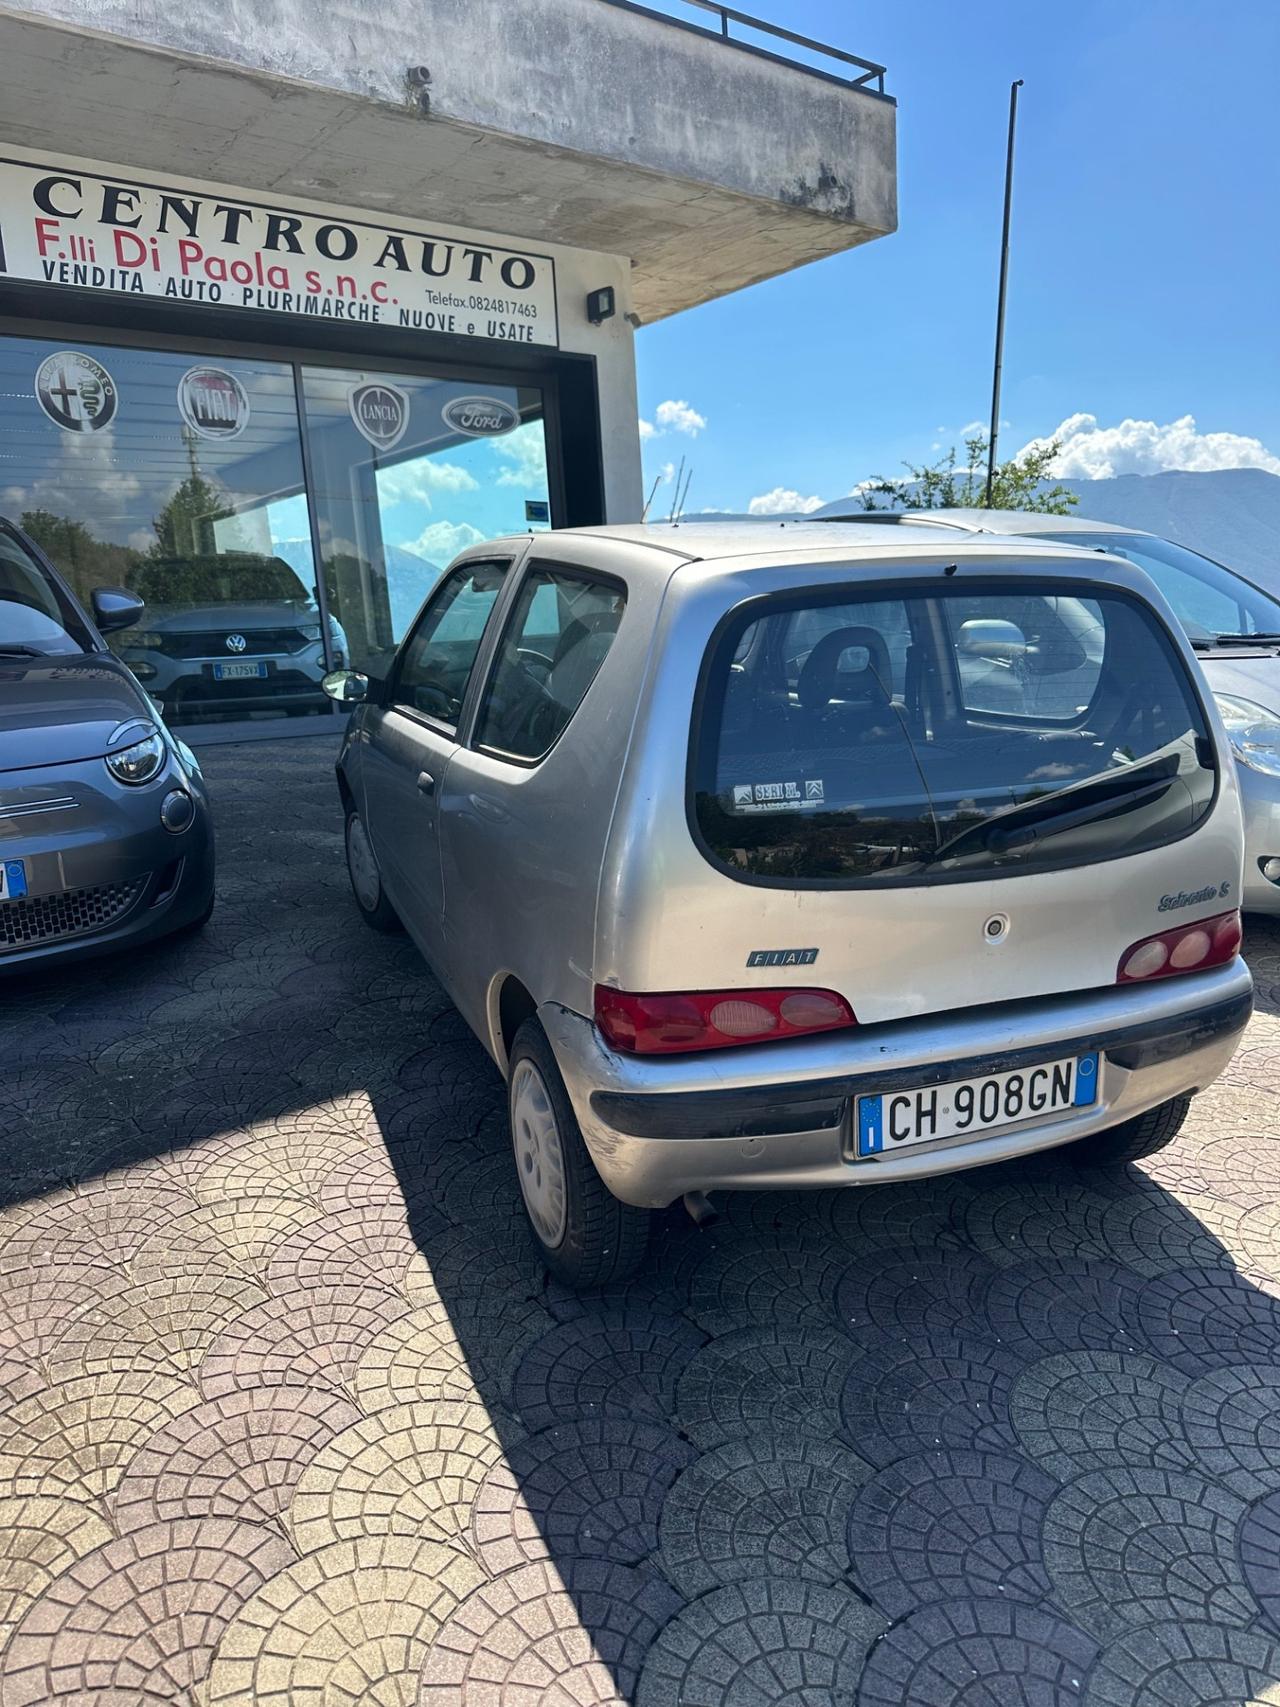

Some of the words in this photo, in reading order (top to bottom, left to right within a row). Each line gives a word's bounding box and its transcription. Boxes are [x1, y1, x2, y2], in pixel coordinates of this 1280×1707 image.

[33, 176, 358, 261] CENTRO
[373, 235, 536, 290] AUTO
[34, 217, 96, 263] F.lli
[113, 229, 161, 272] Di
[178, 239, 290, 290] Paola
[305, 270, 399, 304] s.n.c.
[42, 259, 144, 292] VENDITA
[165, 276, 222, 302] AUTO
[243, 287, 380, 322] PLURIMARCHE
[400, 308, 455, 332] NUOVE
[467, 323, 475, 335] e
[488, 320, 534, 342] USATE
[196, 388, 233, 421] FIAT
[363, 403, 398, 422] LANCIA
[461, 403, 503, 430] Ford
[752, 950, 815, 966] FIAT
[889, 1090, 938, 1141] CH
[954, 1061, 1073, 1129] 908GN
